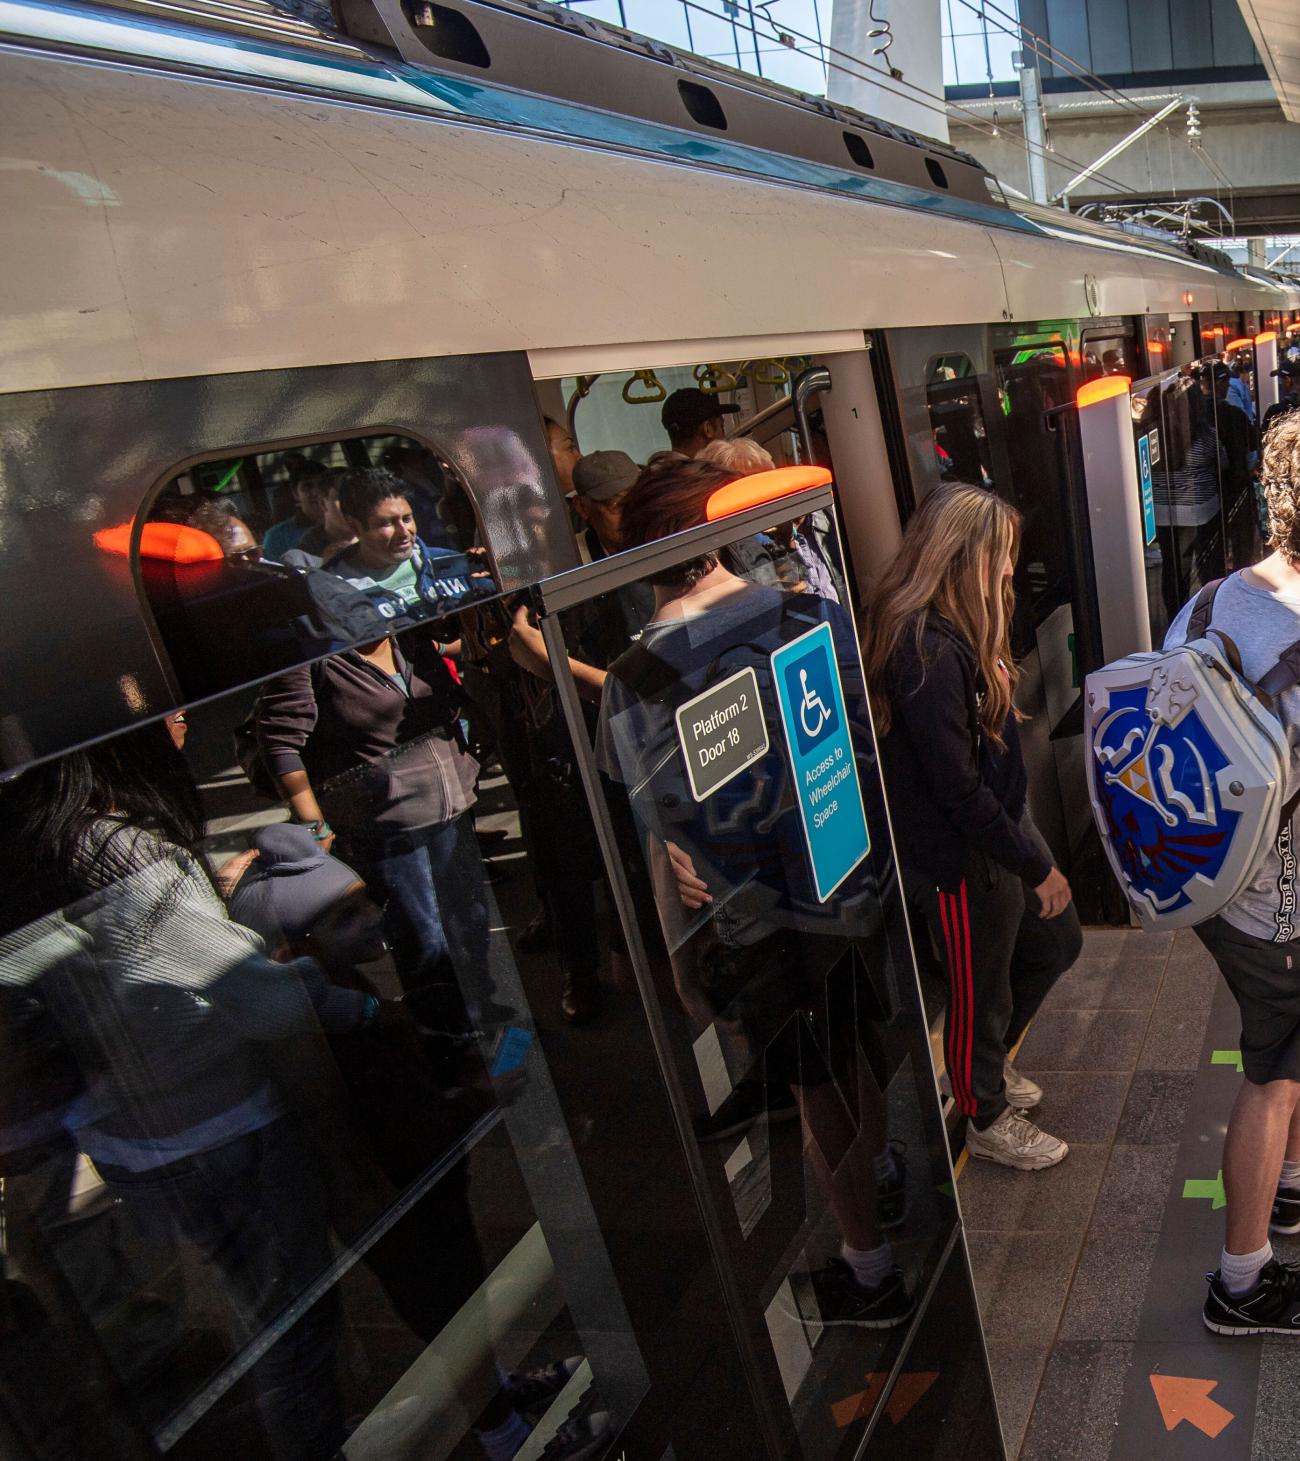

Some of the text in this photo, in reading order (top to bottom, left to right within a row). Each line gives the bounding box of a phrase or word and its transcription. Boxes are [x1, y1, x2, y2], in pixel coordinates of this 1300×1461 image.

[851, 407, 858, 419] 1
[693, 693, 749, 741] Platform 2
[698, 739, 726, 768] Door
[727, 727, 740, 747] 18
[806, 747, 843, 787] Access to
[808, 762, 851, 807] Wheelchair
[814, 800, 838, 828] Space
